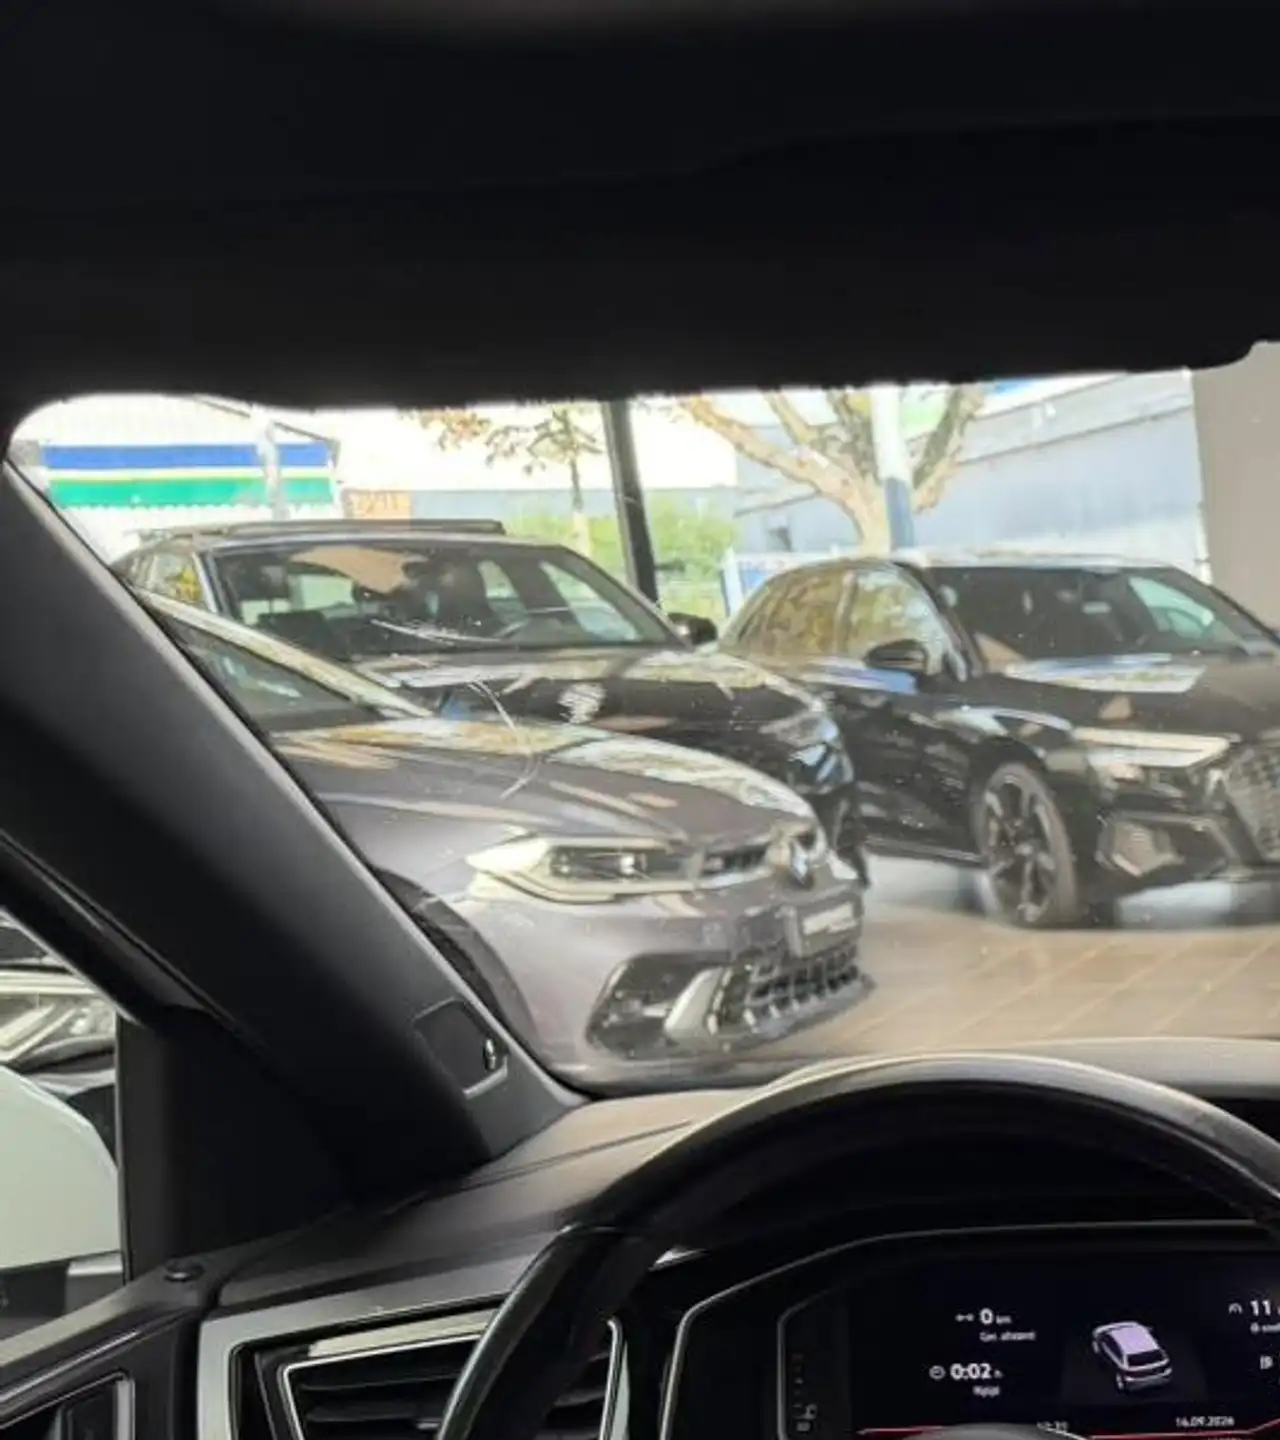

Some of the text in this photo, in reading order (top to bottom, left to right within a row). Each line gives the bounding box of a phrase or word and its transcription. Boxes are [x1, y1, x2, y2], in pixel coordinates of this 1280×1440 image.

[979, 1307, 994, 1325] 0
[1250, 1300, 1272, 1316] 11
[950, 1363, 992, 1380] 0:02
